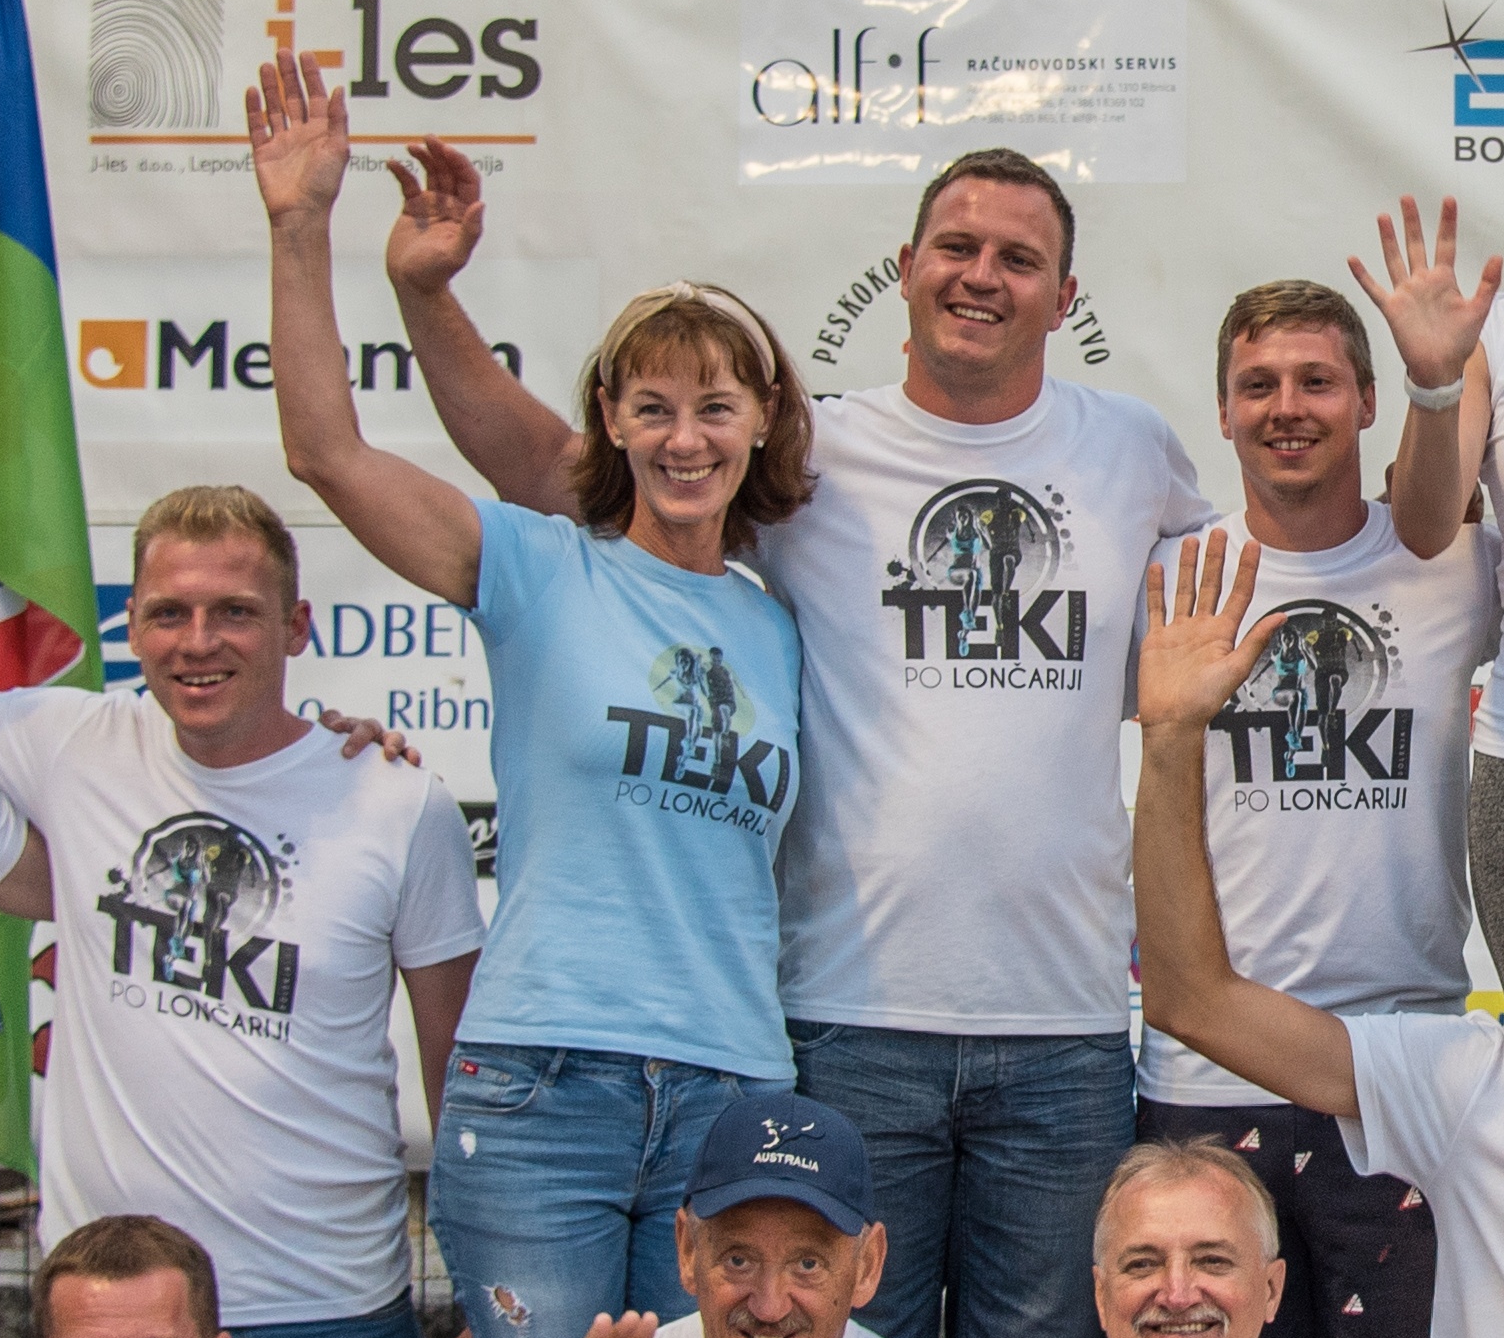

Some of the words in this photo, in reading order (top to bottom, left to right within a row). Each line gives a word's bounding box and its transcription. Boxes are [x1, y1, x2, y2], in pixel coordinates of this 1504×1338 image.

[967, 55, 1105, 72] RAČUNOVODSKI
[1114, 56, 1178, 71] SERVIS
[881, 589, 1088, 662] TEKI
[905, 666, 942, 689] PO
[953, 662, 1083, 691] LONČARIJI
[607, 705, 791, 814] TEKI
[1208, 708, 1415, 784] TEKI
[615, 781, 653, 806] PO
[1234, 790, 1270, 813] PO
[1280, 782, 1408, 811] LONČARIJI
[96, 895, 301, 1014] TEKI
[110, 979, 147, 1009] PO
[157, 990, 291, 1043] LONČARIJI
[753, 1151, 820, 1173] AUSTRALIA
